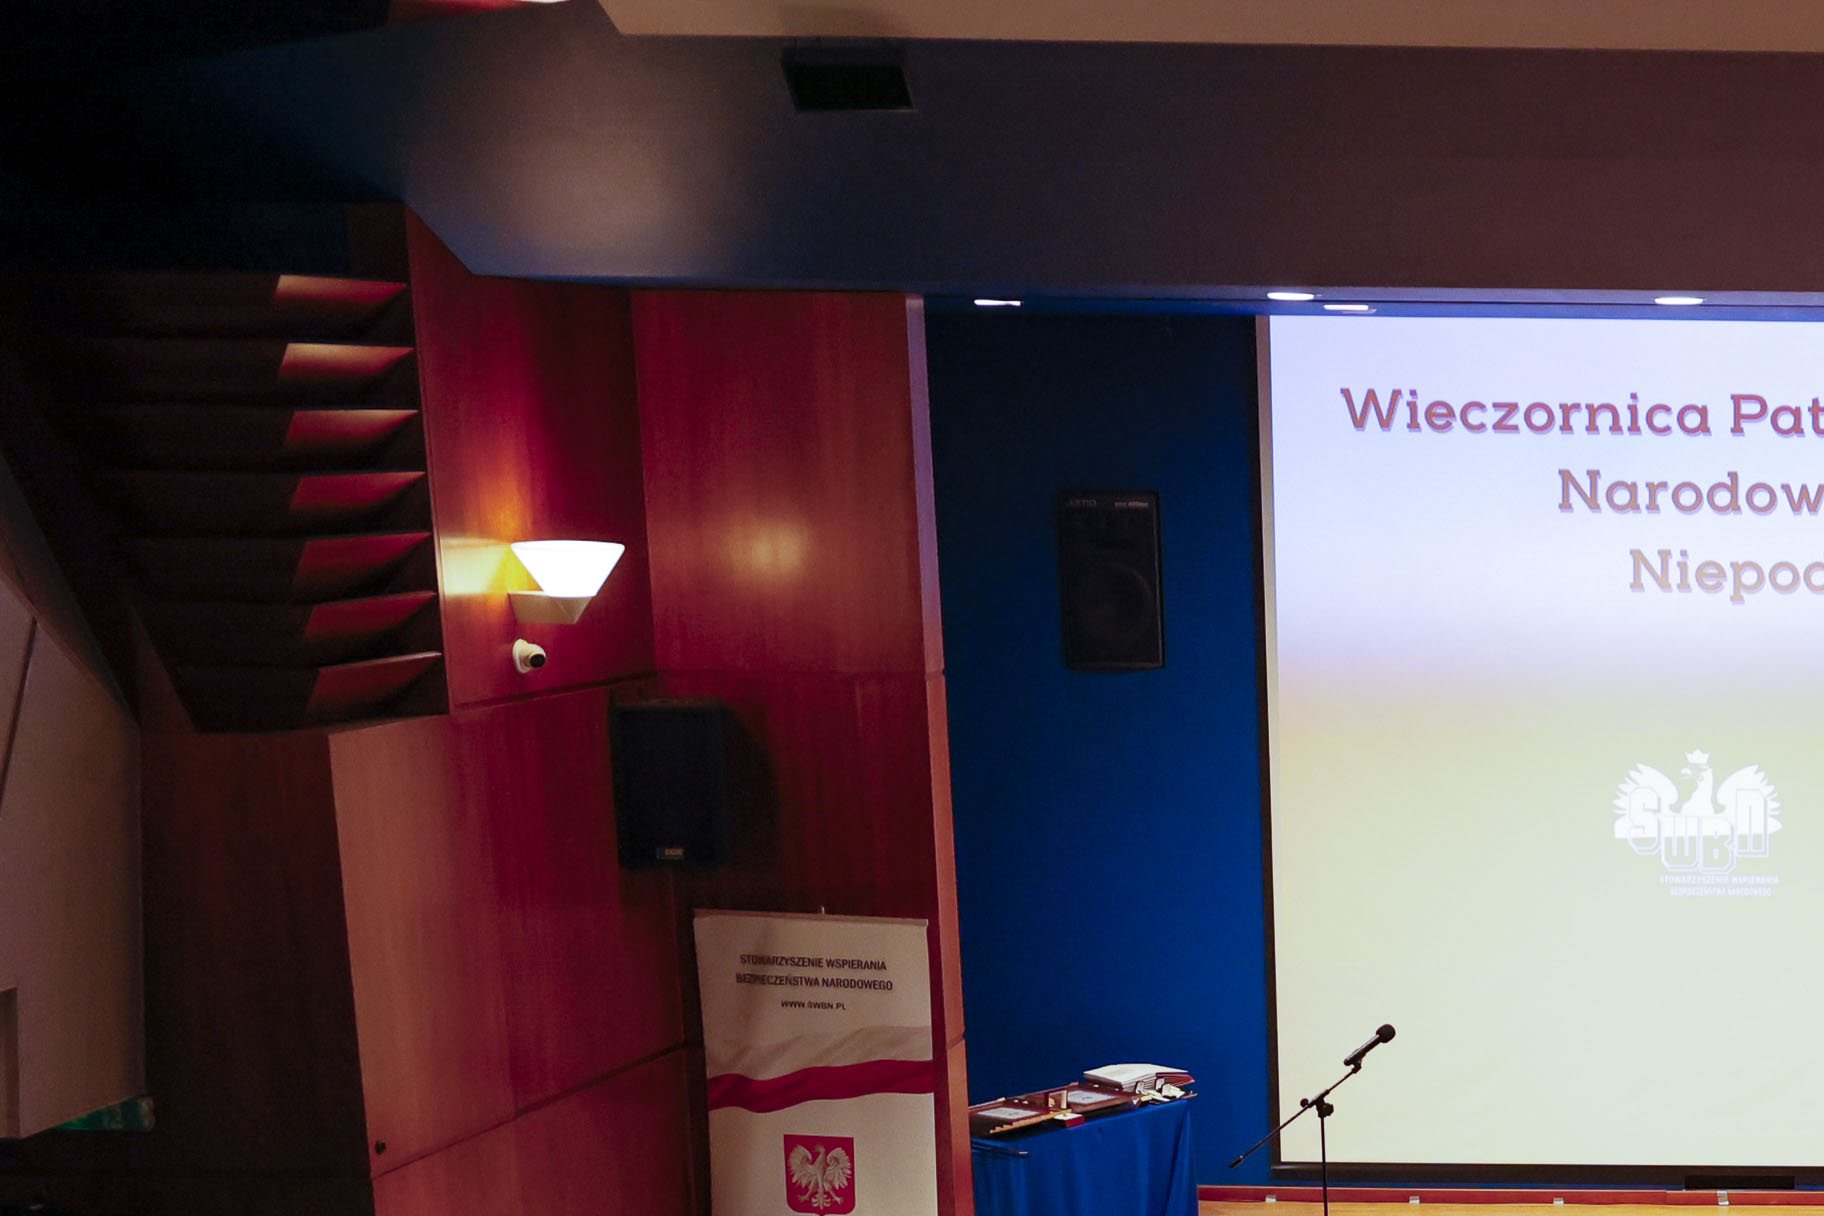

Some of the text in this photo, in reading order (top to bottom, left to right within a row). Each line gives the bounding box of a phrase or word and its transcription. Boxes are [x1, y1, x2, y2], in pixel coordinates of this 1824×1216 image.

[1340, 388, 1711, 434] Wieczornica
[739, 953, 887, 970] STOWARZYSZENIE WSPIERANIA
[736, 972, 893, 991] BEZPIECZEŃSTWA NARODOWEGO
